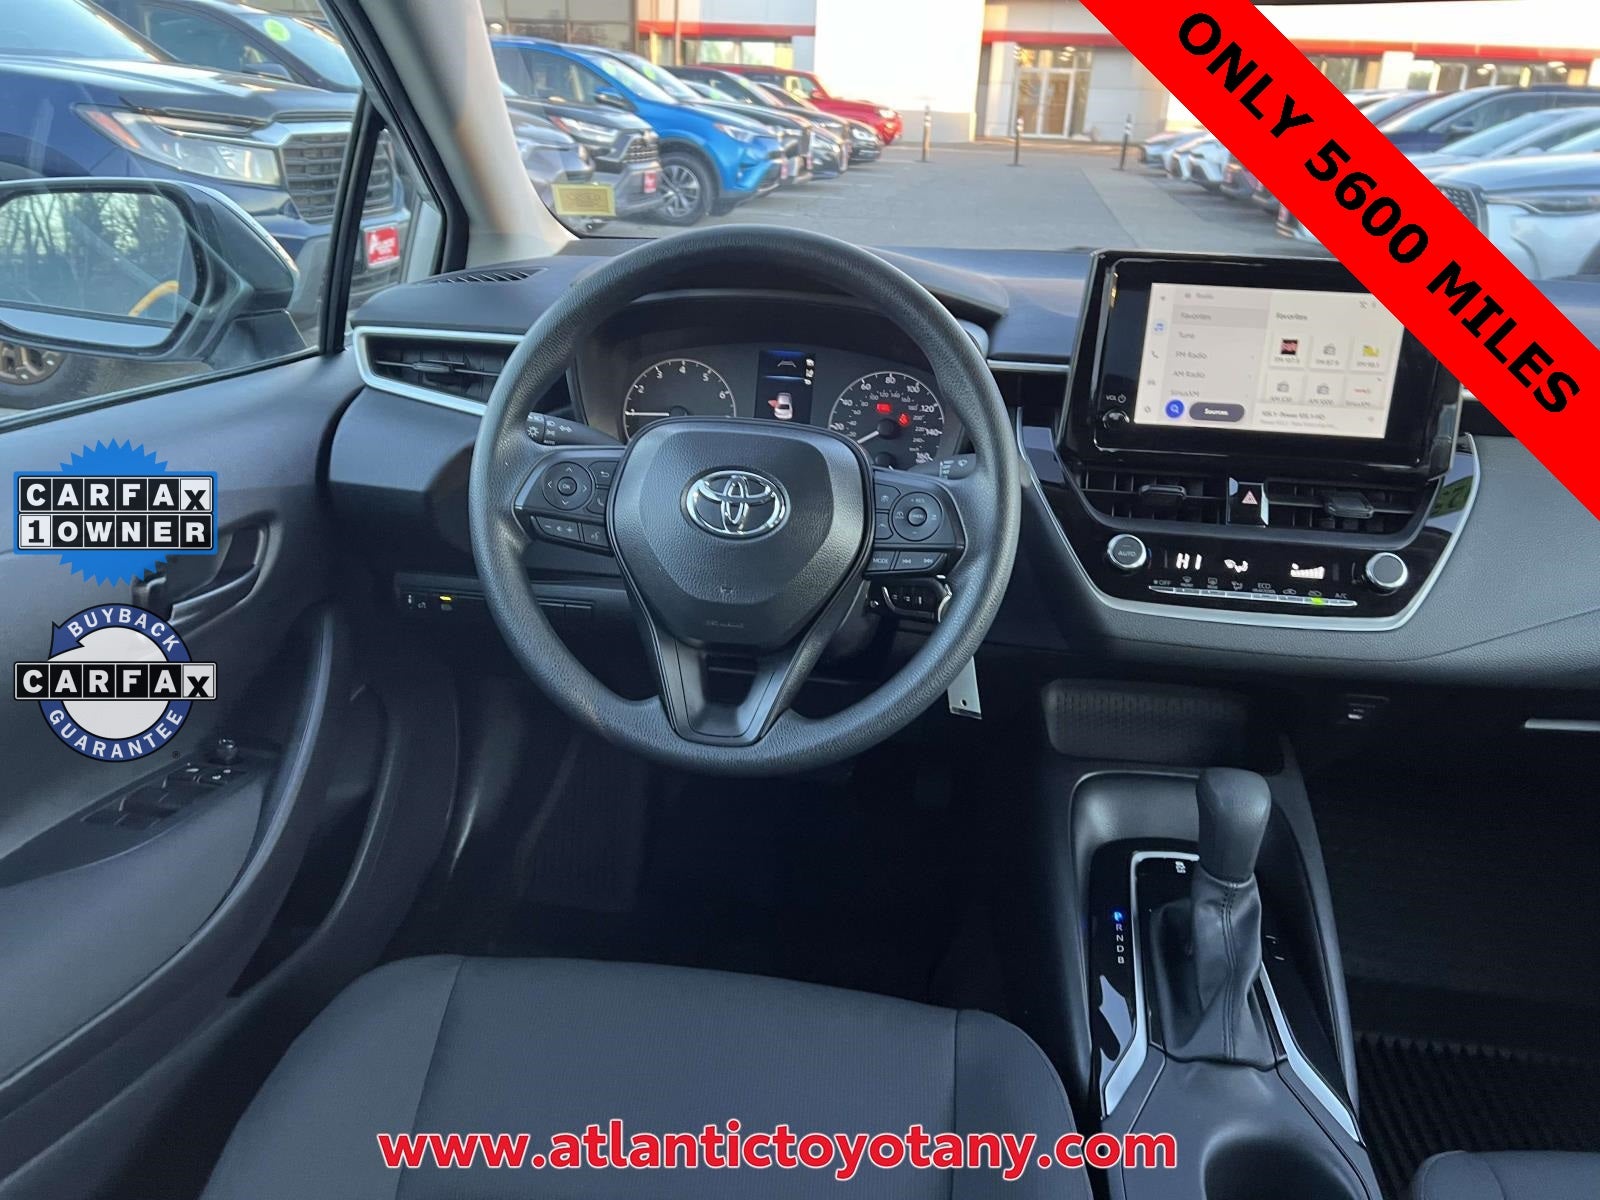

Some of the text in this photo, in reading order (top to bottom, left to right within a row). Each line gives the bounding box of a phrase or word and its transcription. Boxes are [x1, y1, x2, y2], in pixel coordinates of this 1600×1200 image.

[679, 366, 686, 374] 4
[656, 370, 663, 379] 3
[703, 373, 709, 381] 5
[885, 376, 896, 384] 80
[638, 385, 645, 393] 2
[906, 385, 920, 393] 100
[719, 391, 726, 399] 6
[1204, 408, 1229, 416] Sources
[1115, 923, 1123, 932] R
[1116, 945, 1125, 953] D
